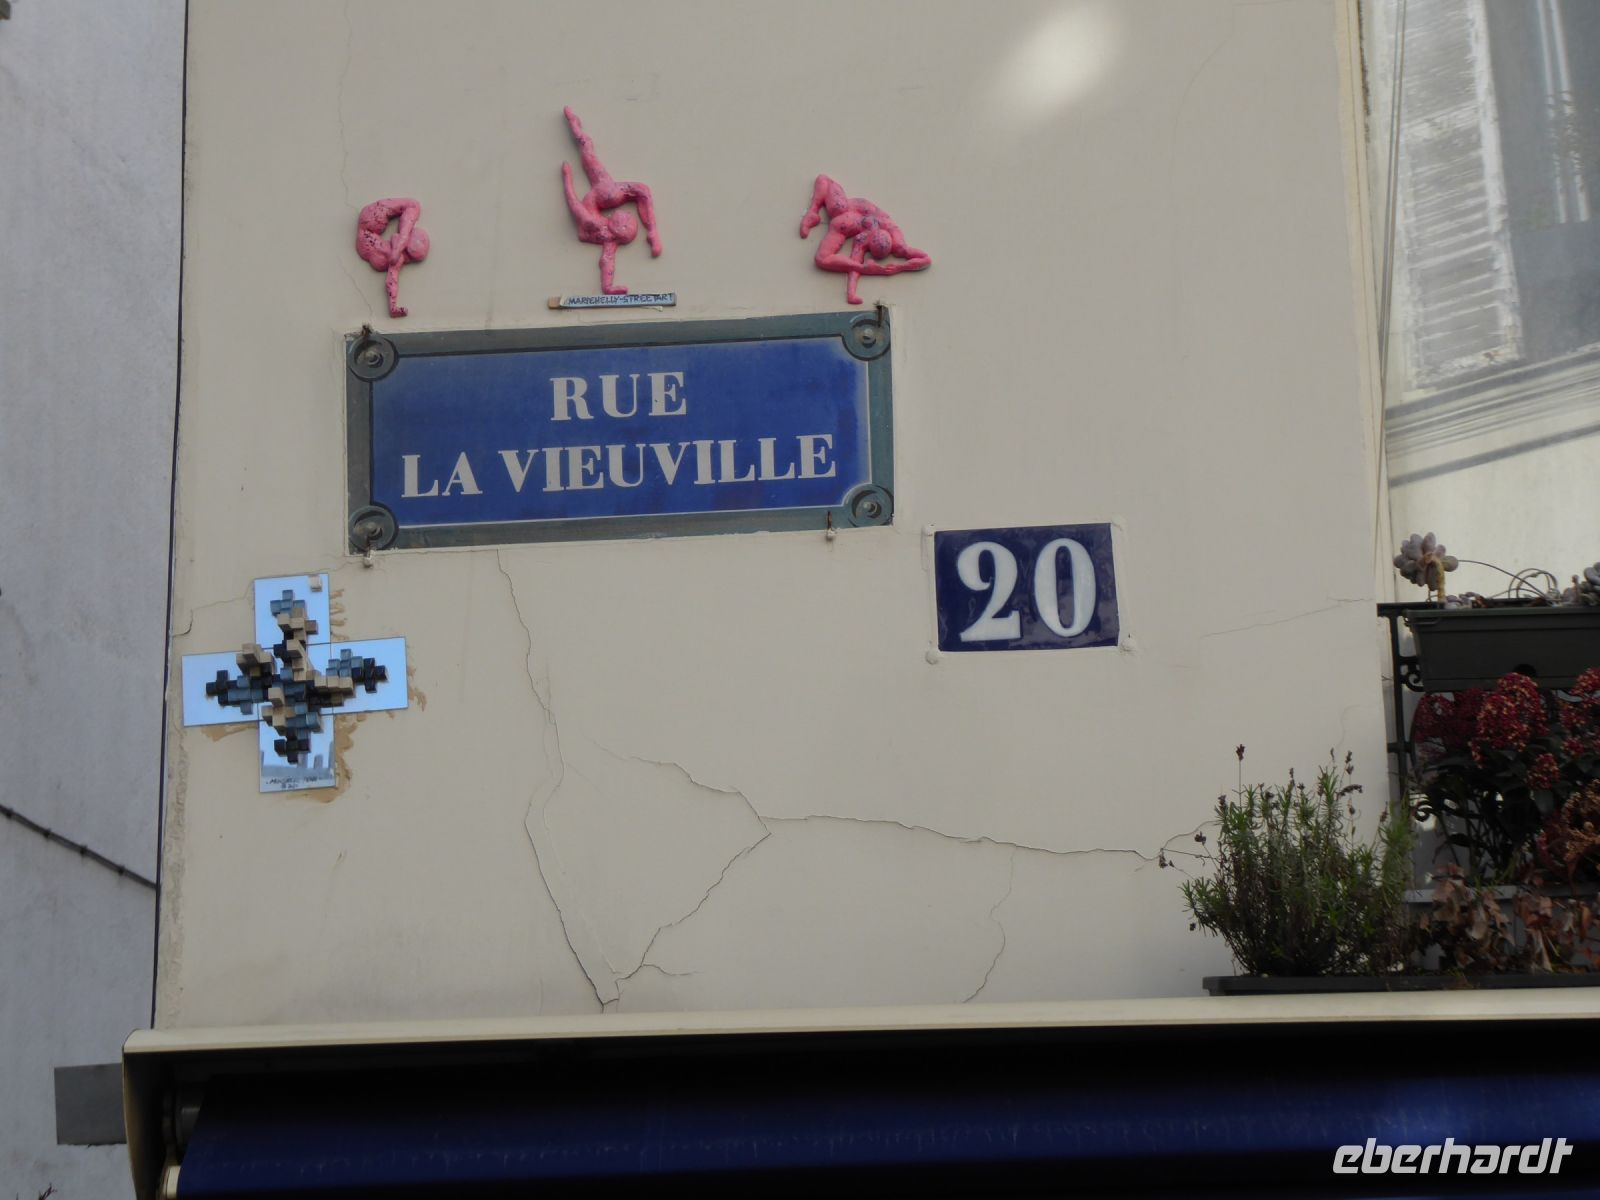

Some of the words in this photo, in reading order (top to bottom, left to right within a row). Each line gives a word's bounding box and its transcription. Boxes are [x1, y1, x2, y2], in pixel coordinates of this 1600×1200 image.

[549, 371, 687, 421] RUE
[401, 451, 483, 498] LA
[498, 433, 836, 493] VIEUVILLE
[957, 538, 1096, 642] 20
